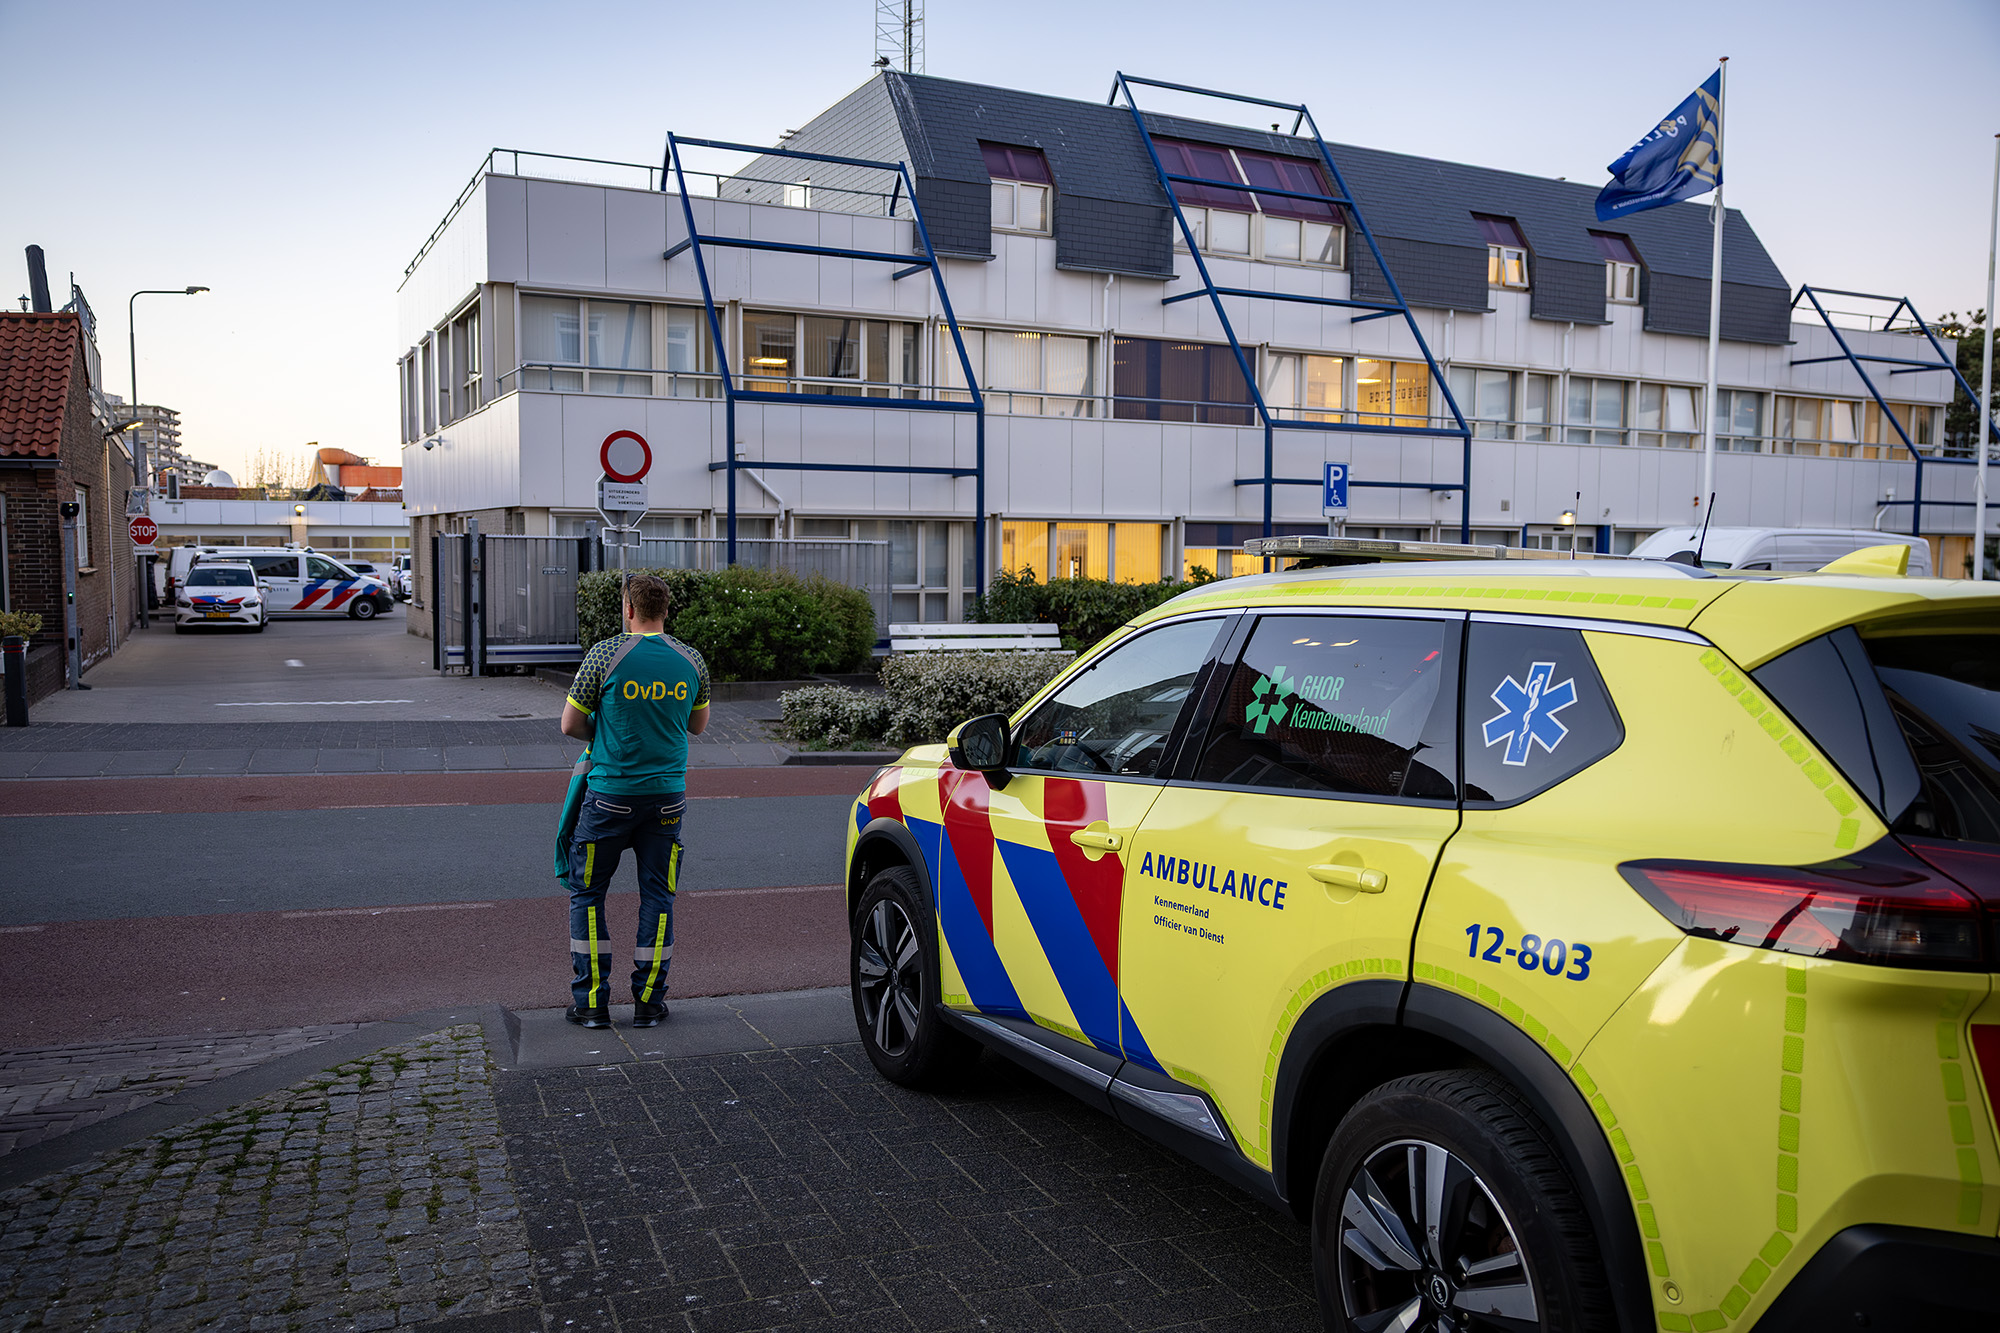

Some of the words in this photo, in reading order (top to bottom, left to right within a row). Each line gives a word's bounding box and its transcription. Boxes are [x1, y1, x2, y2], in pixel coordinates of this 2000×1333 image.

[1330, 466, 1343, 489] P
[130, 525, 157, 537] STOP
[623, 680, 688, 701] OvD-G
[1299, 674, 1345, 701] GHOR
[1289, 702, 1391, 735] Kennemerland
[1140, 851, 1288, 911] AMBULANCE
[1154, 895, 1210, 919] Kennemerland
[1153, 914, 1182, 931] Officier
[1183, 924, 1198, 936] van
[1199, 927, 1225, 945] Dienst
[1465, 923, 1593, 982] 12-803
